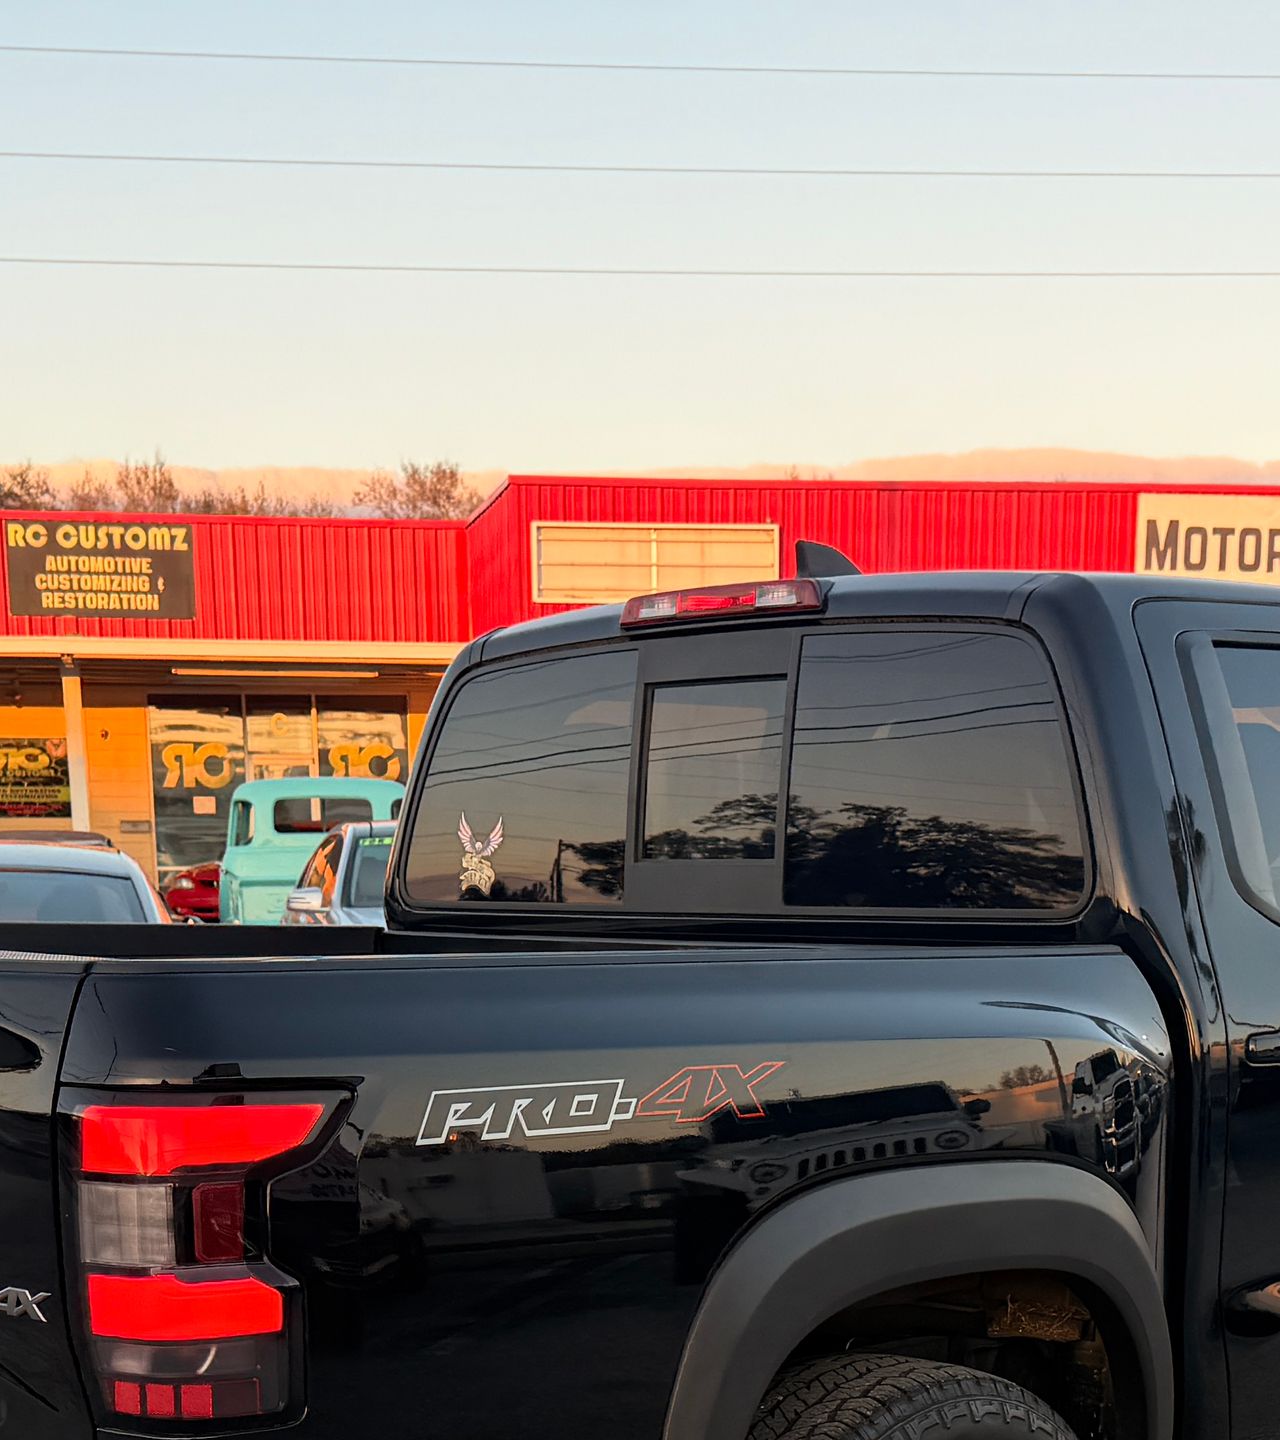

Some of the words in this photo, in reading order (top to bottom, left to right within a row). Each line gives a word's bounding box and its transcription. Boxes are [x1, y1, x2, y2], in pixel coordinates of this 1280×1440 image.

[7, 523, 48, 548] RC
[55, 524, 189, 551] CUSTOMZ
[45, 555, 153, 574] AUTOMOTIVE
[34, 573, 151, 592] CUSTOMIZING
[41, 592, 160, 611] RESTORATION
